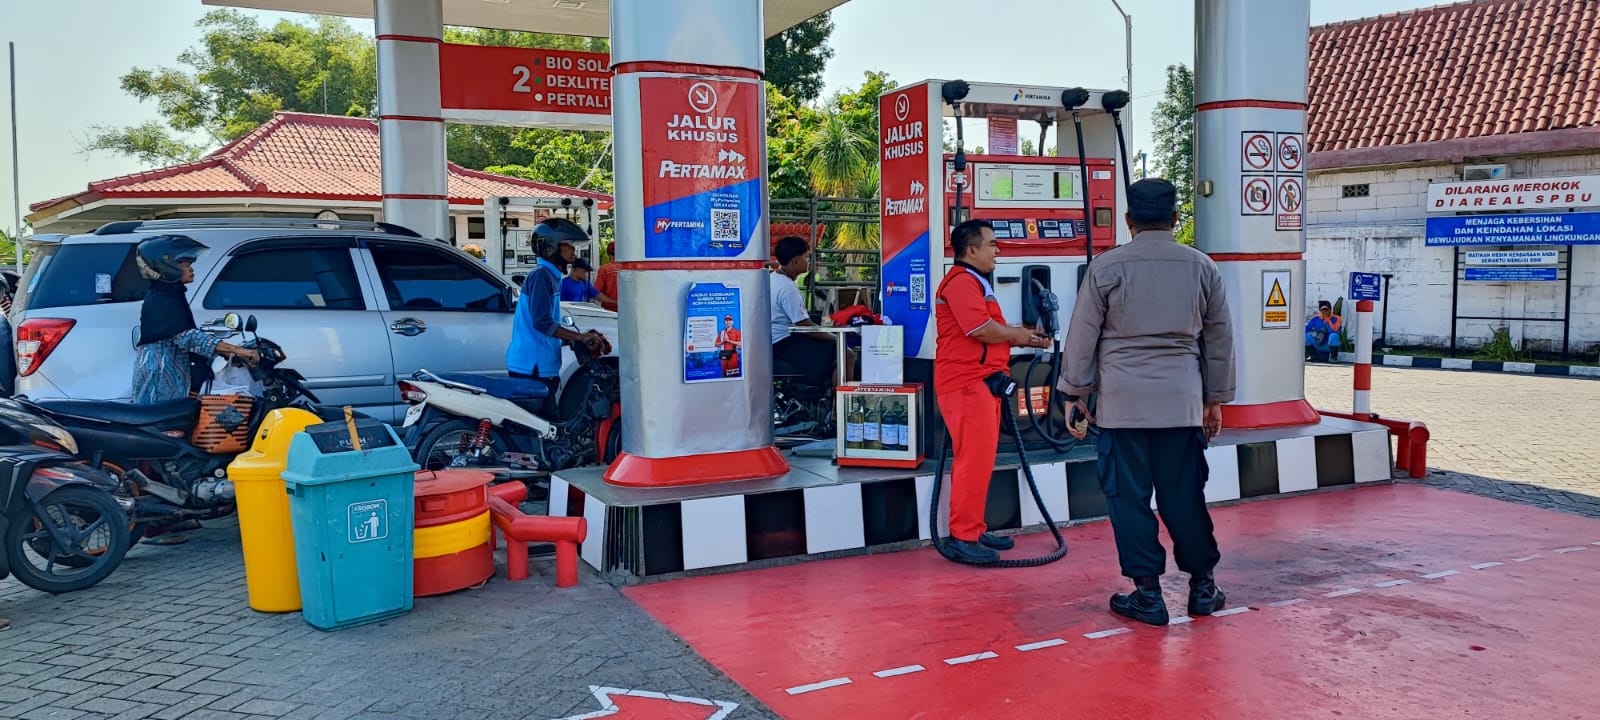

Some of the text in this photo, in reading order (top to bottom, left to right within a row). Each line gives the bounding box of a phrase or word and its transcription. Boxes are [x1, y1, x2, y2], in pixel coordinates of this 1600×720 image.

[545, 56, 572, 70] BIO
[512, 65, 531, 93] 2
[546, 74, 609, 91] DEXLITE
[547, 93, 611, 108] PERTALI
[666, 114, 736, 131] JALUR
[667, 129, 738, 143] KHUSUS
[885, 121, 923, 145] JALUR
[885, 141, 924, 160] KHUSUS
[659, 160, 746, 179] PERTAMAX
[1445, 181, 1581, 195] DILARANG MEROKOK
[1535, 193, 1592, 204] SPBU
[885, 198, 925, 217] PERTAMAX
[1465, 216, 1562, 226] MENJAGA KEBERSIHAN
[1476, 226, 1534, 234] KEINDAHAN
[1536, 225, 1573, 233] LOKASI
[1427, 233, 1600, 244] MEWUJUDKAN KENYAMANAN LINGKUNGAN
[339, 437, 367, 447] PUH
